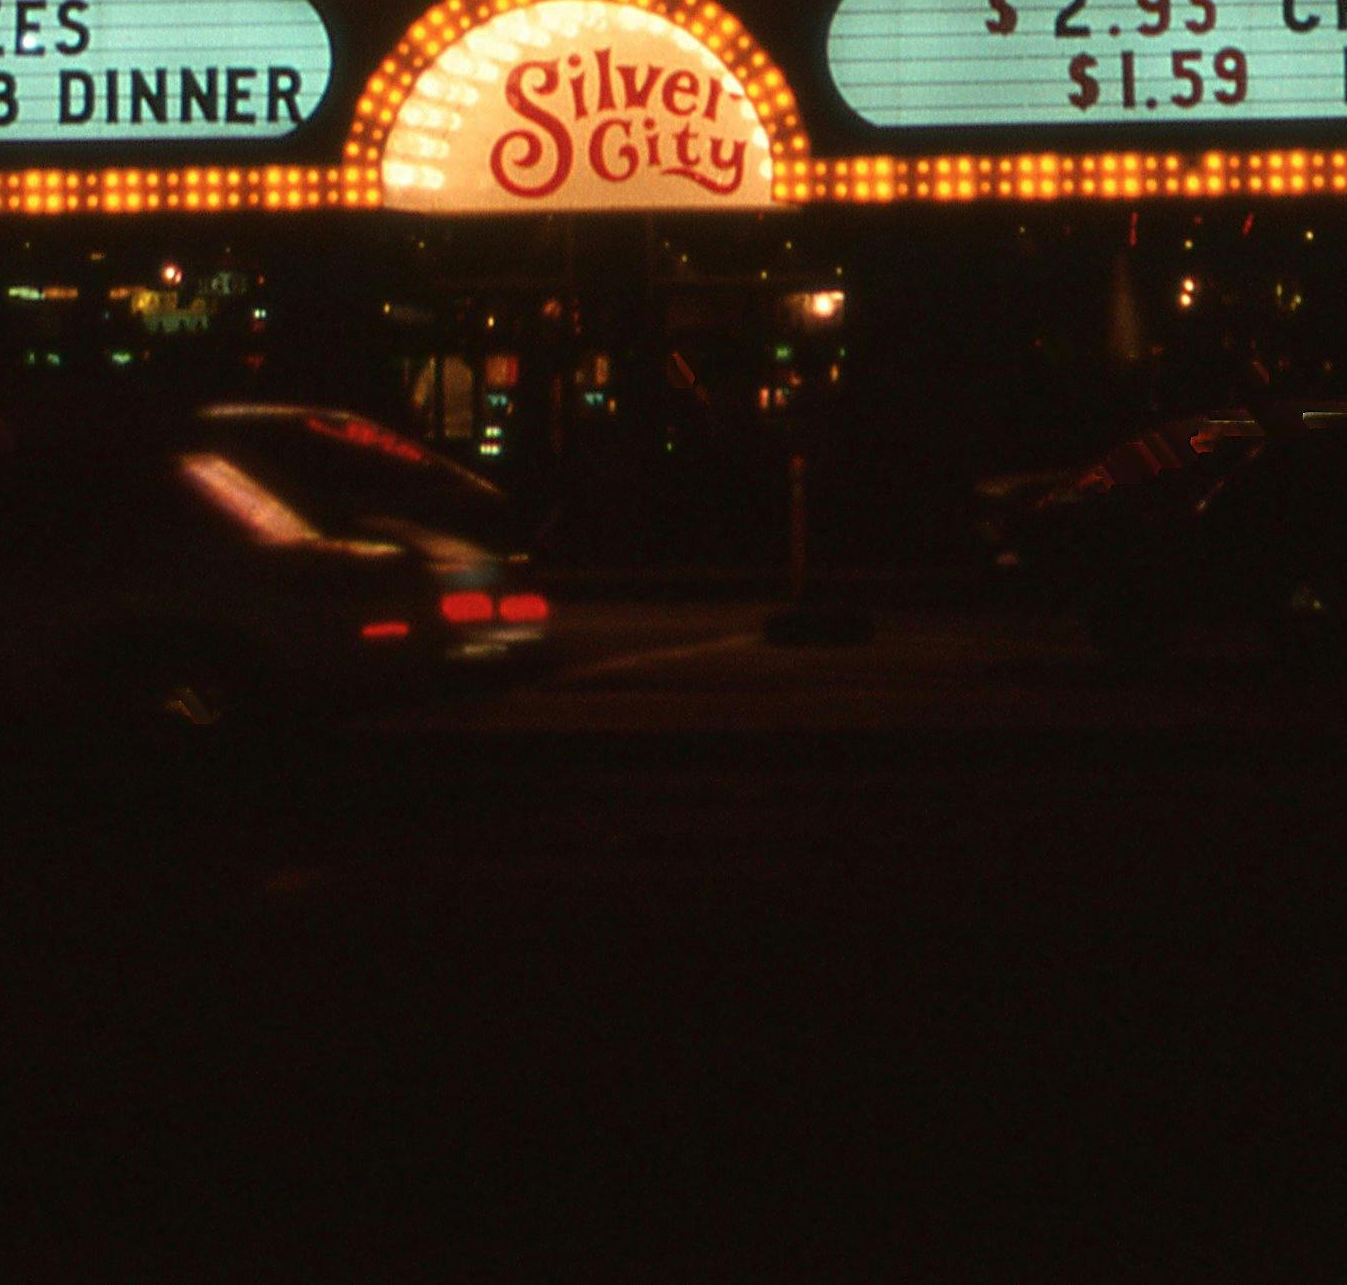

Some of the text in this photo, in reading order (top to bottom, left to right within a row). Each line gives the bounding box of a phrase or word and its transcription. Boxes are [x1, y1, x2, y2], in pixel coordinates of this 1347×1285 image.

[58, 66, 306, 125] DINNER
[1067, 47, 1248, 112] $1.59
[489, 48, 748, 199] Silver City
